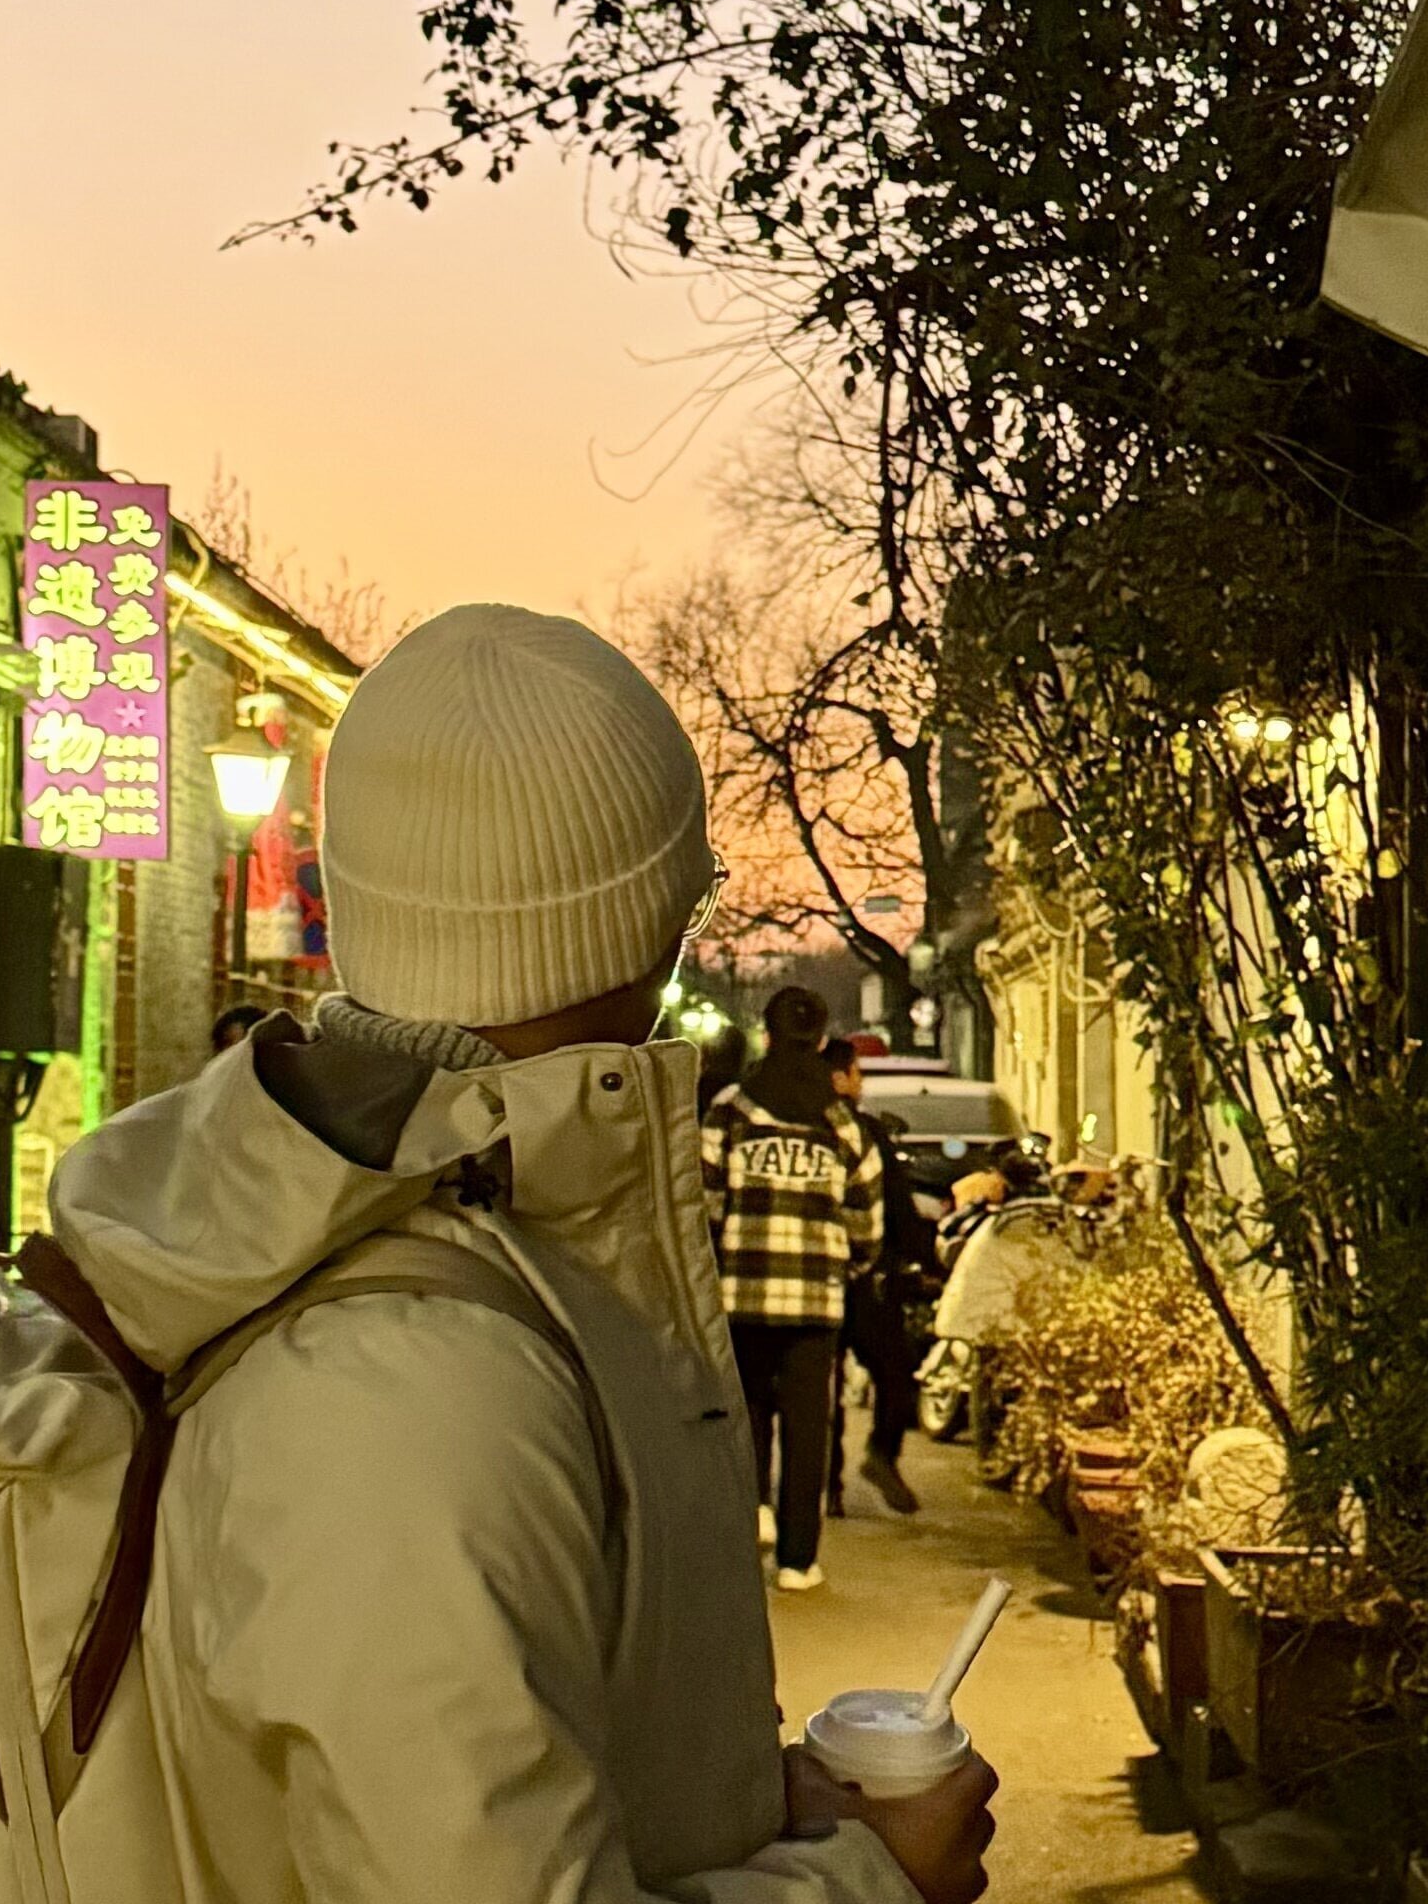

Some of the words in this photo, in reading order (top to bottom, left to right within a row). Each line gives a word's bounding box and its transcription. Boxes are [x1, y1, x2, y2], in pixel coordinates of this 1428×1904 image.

[27, 488, 108, 849] 非遗博物馆
[107, 504, 162, 694] 免费参观
[732, 1135, 841, 1184] YALE
